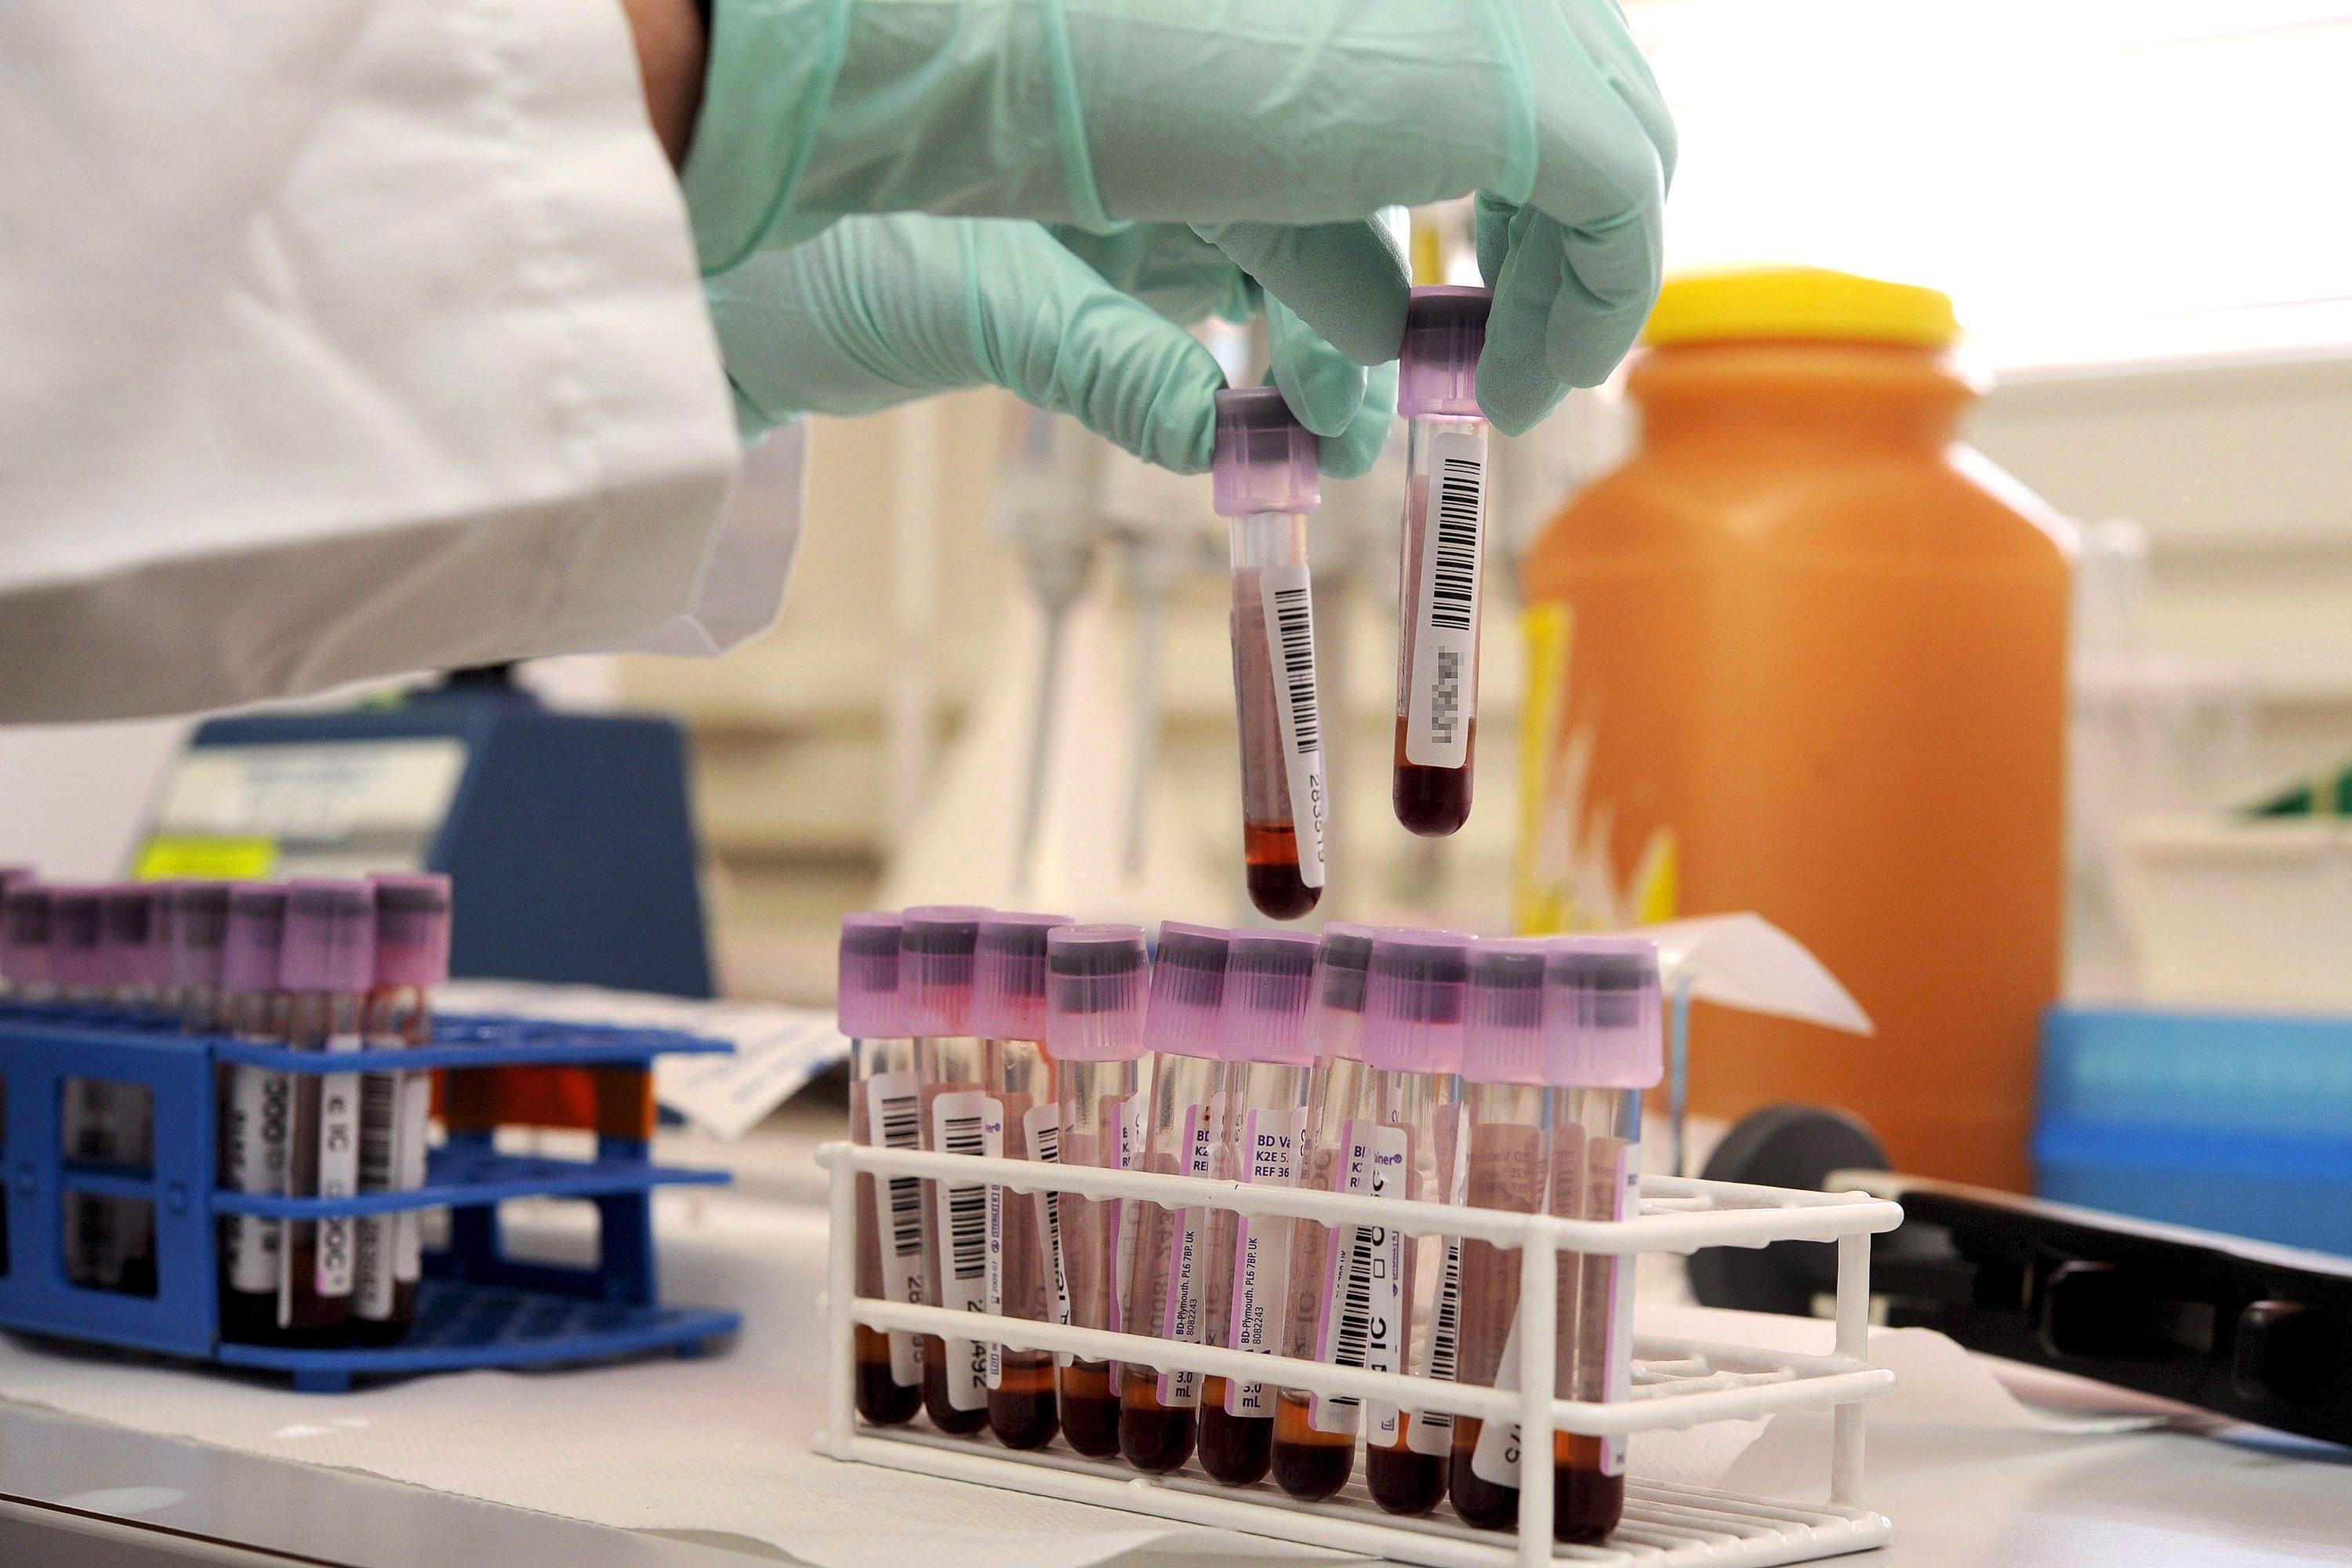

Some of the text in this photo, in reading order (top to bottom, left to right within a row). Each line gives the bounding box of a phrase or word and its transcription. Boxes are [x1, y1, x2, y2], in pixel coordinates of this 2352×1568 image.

[1258, 1134, 1276, 1147] BD
[1256, 1151, 1289, 1163] K2E 5.
[1254, 1166, 1290, 1178] REF 36
[1249, 1238, 1258, 1250] UK
[1181, 1263, 1191, 1278] PL6
[1186, 1231, 1194, 1243] UK
[1246, 1271, 1255, 1286] PL6
[1187, 1299, 1197, 1336] 8082243
[1253, 1307, 1264, 1345] 8082243
[1370, 1317, 1386, 1349] IC
[1175, 1386, 1191, 1398] mL
[1242, 1396, 1261, 1408] mL
